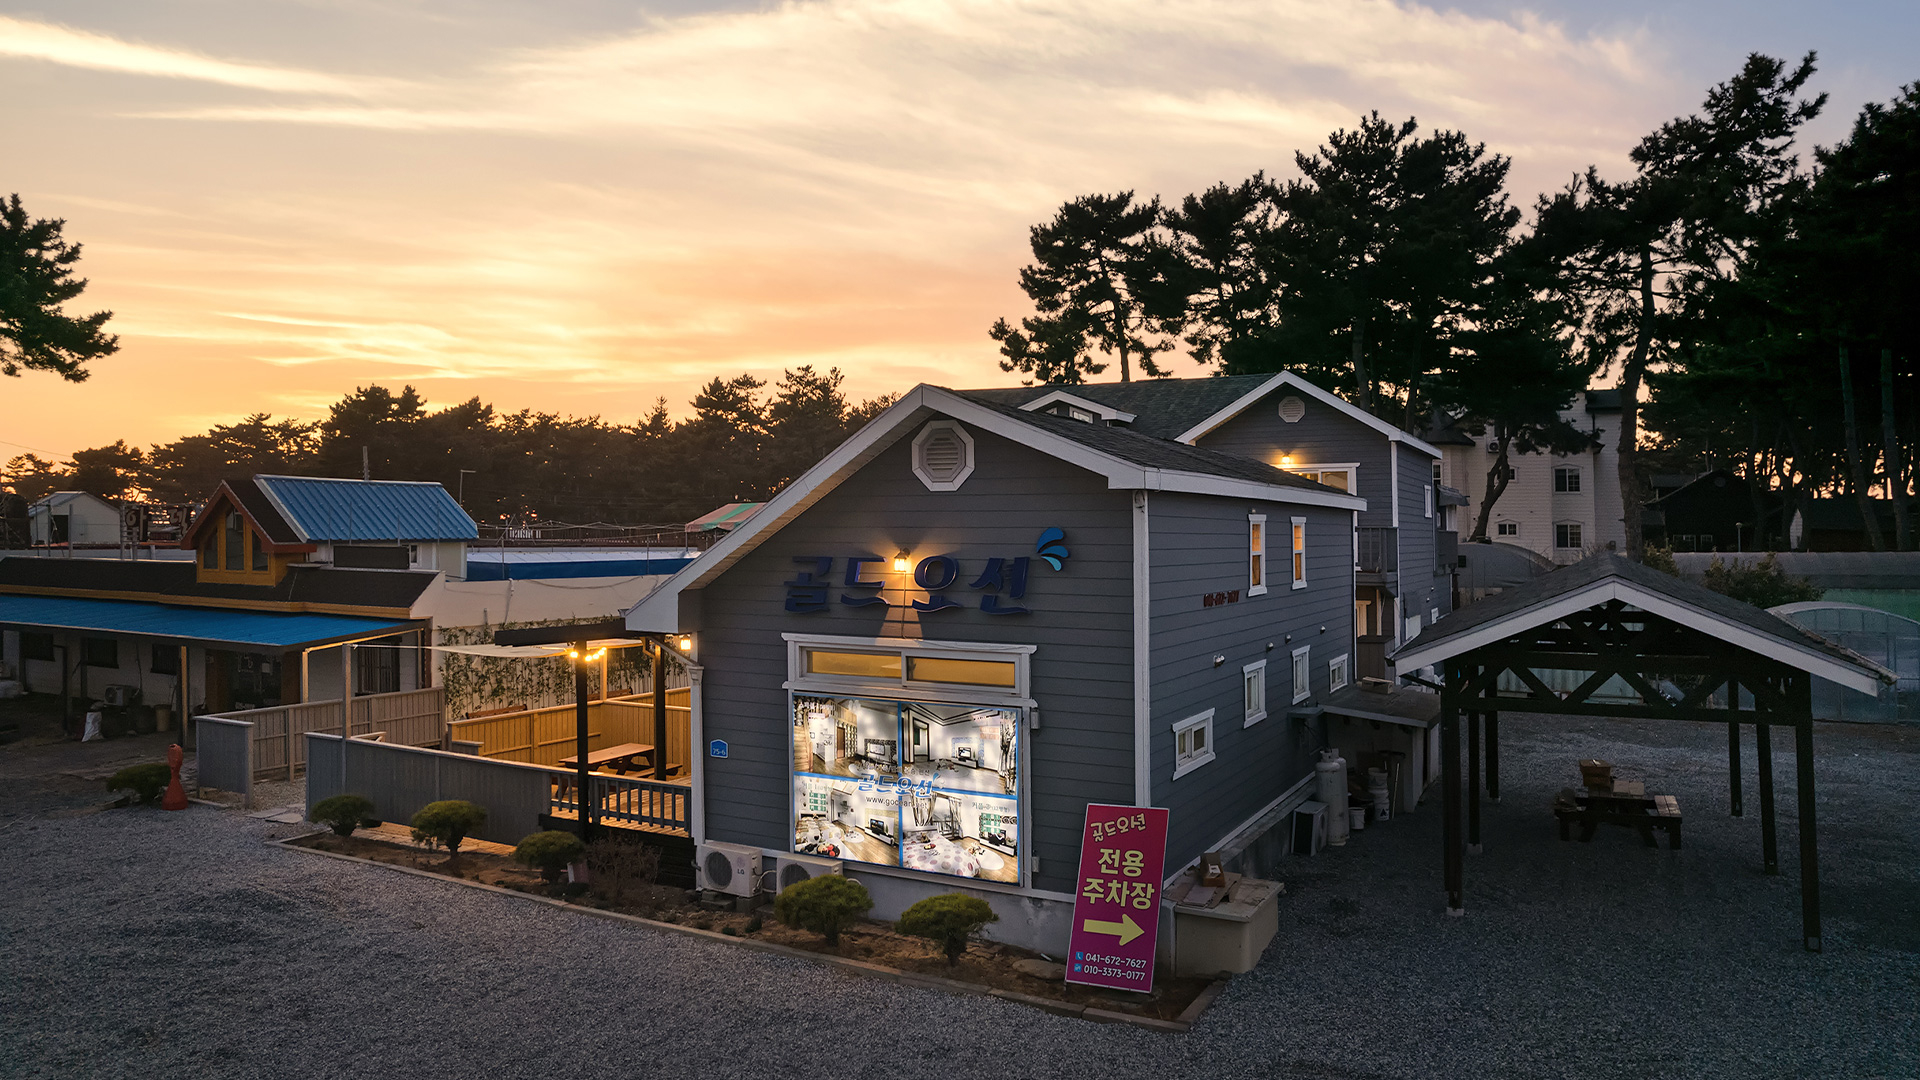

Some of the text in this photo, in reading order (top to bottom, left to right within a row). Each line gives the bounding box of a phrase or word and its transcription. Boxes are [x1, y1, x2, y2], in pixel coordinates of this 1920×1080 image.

[783, 555, 1032, 615] 골드오션
[712, 747, 726, 756] 75-6
[857, 772, 933, 798] 골드오션
[1090, 812, 1146, 842] 골드오션
[1097, 848, 1145, 877] 전용
[1082, 878, 1155, 910] 주차장
[1083, 965, 1146, 981] 010-3373-0177
[1085, 952, 1147, 968] 041-672-7627
